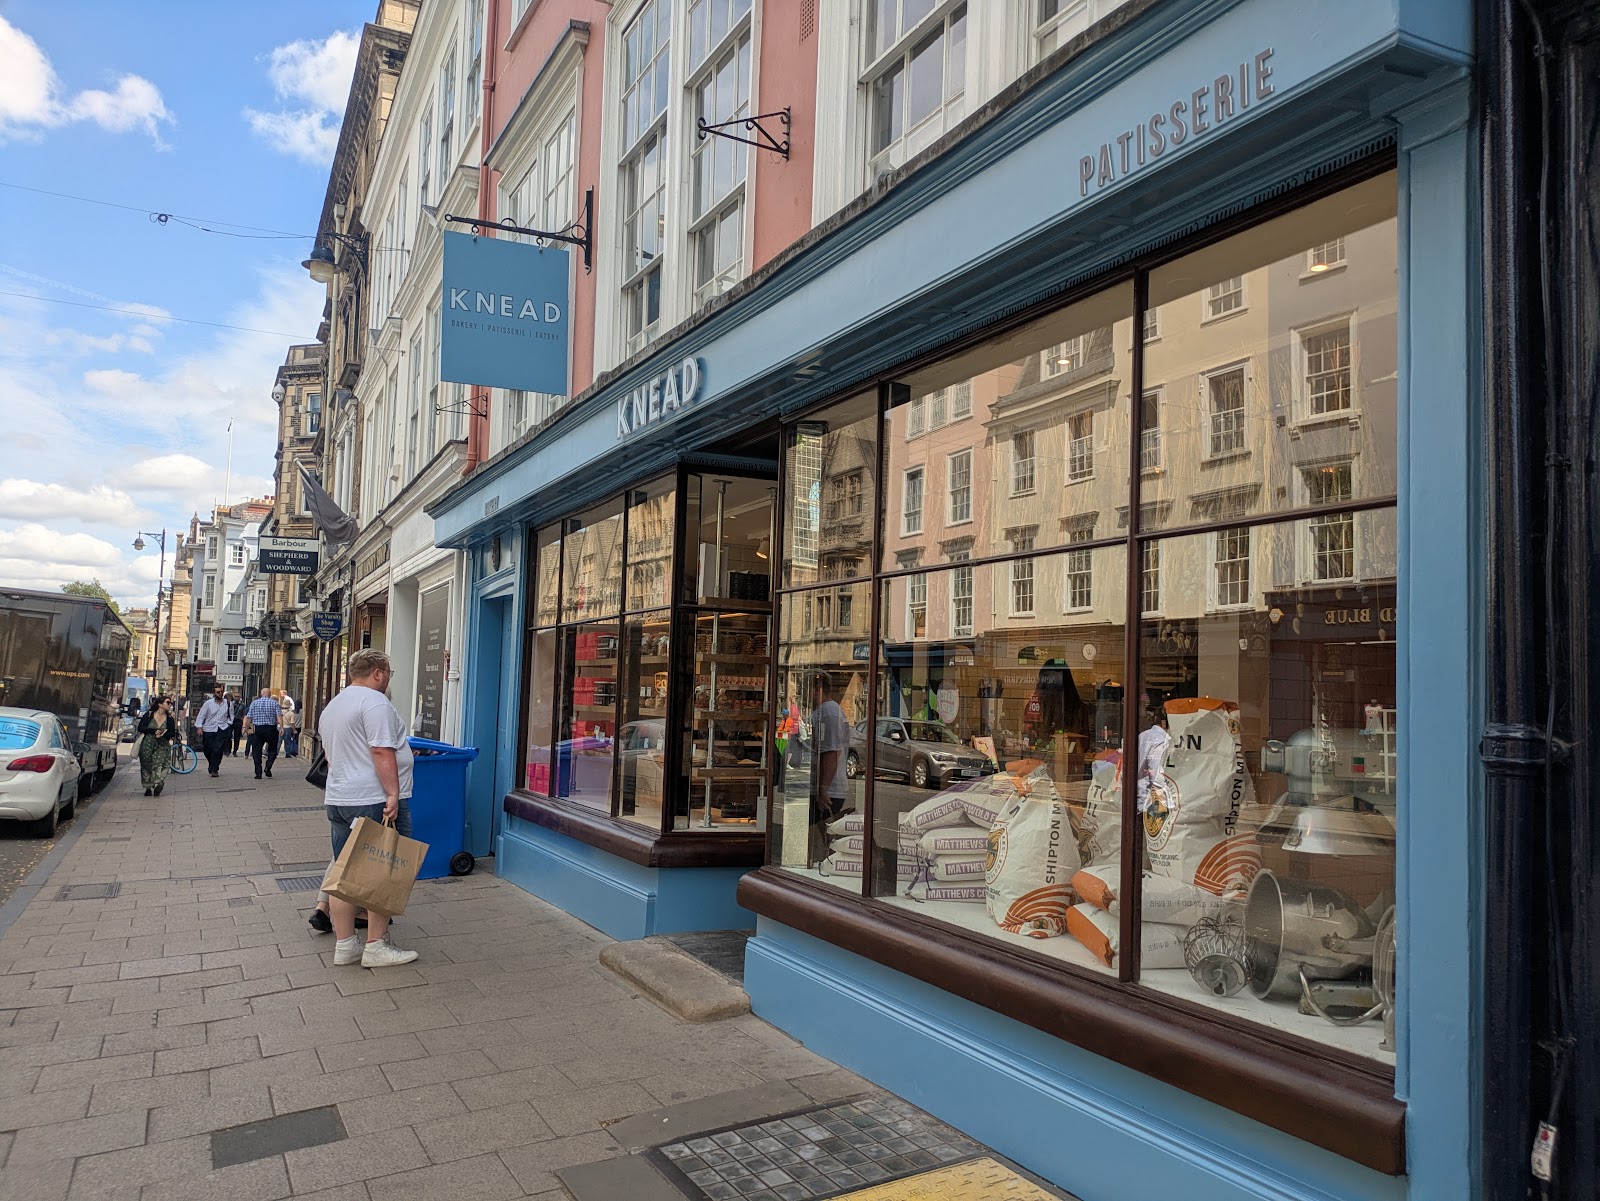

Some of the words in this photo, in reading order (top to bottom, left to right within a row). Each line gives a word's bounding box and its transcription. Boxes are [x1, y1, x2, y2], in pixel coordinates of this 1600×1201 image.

[1079, 47, 1274, 197] PATISSERIE
[450, 287, 561, 324] KNEAD
[451, 320, 478, 330] BAKERY
[487, 325, 526, 337] PATISSERIE
[535, 331, 560, 341] EATERY
[616, 356, 699, 440] KNEAD
[272, 539, 307, 547] Barbour
[269, 552, 309, 560] SHEPHERD
[266, 564, 312, 572] WOODWARD
[50, 669, 91, 678] www.ups.com
[917, 803, 954, 826] MATTHEWS
[362, 842, 406, 867] PRIMARK
[936, 839, 984, 849] MATTHEWS
[1046, 819, 1061, 885] SHIPTON
[927, 889, 975, 899] MATTHEWS
